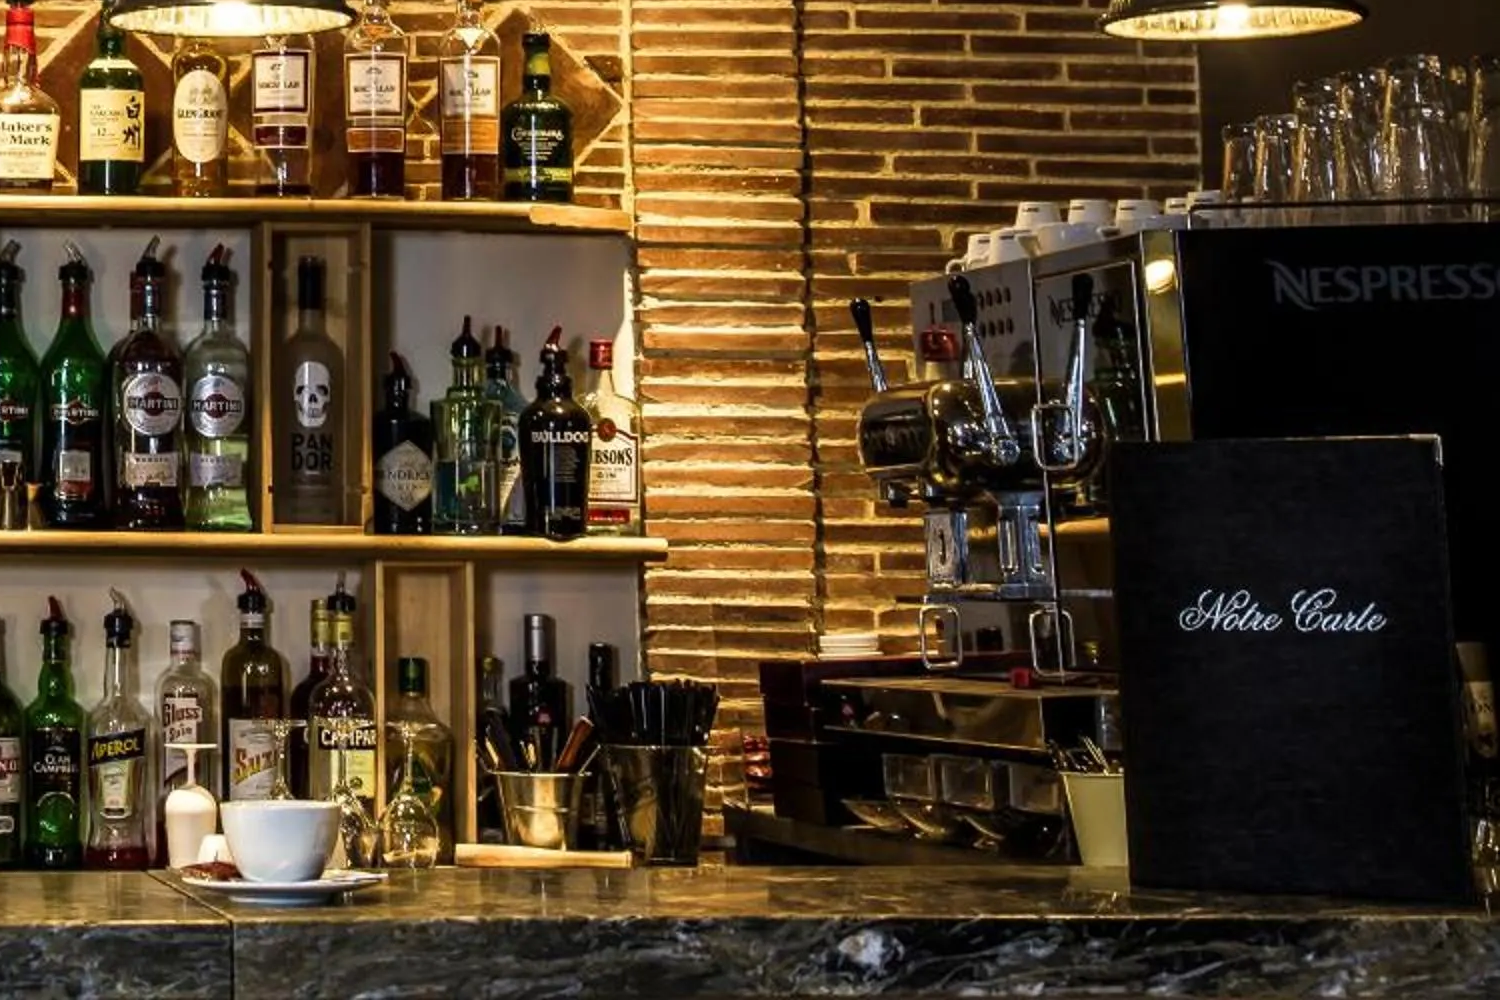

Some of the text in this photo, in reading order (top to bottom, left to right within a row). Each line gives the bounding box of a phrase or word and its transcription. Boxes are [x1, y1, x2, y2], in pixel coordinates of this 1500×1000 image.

[1263, 259, 1500, 312] NESPRESS
[292, 433, 333, 450] PAN
[531, 430, 589, 442] BULLDOG
[292, 451, 332, 471] DOR
[1179, 588, 1283, 632] Notre
[321, 729, 376, 746] CAMPAR
[92, 738, 141, 759] APEROL
